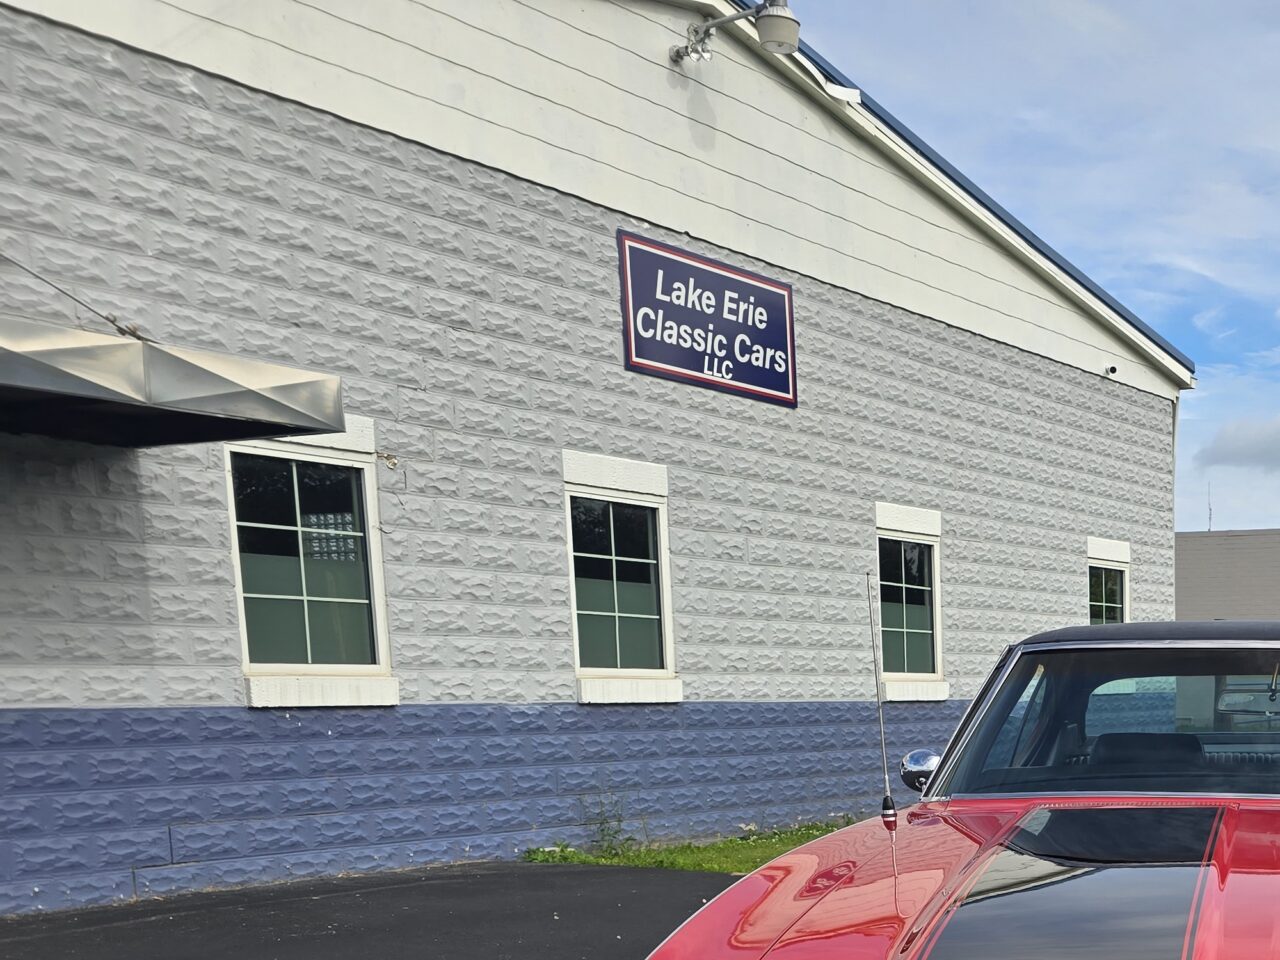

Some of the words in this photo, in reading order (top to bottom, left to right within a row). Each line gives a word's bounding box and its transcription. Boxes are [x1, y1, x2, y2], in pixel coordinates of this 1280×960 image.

[656, 269, 716, 315] Lake
[722, 289, 768, 330] Erie
[636, 306, 728, 358] Classic
[734, 333, 787, 373] Cars
[703, 355, 734, 380] LLC
